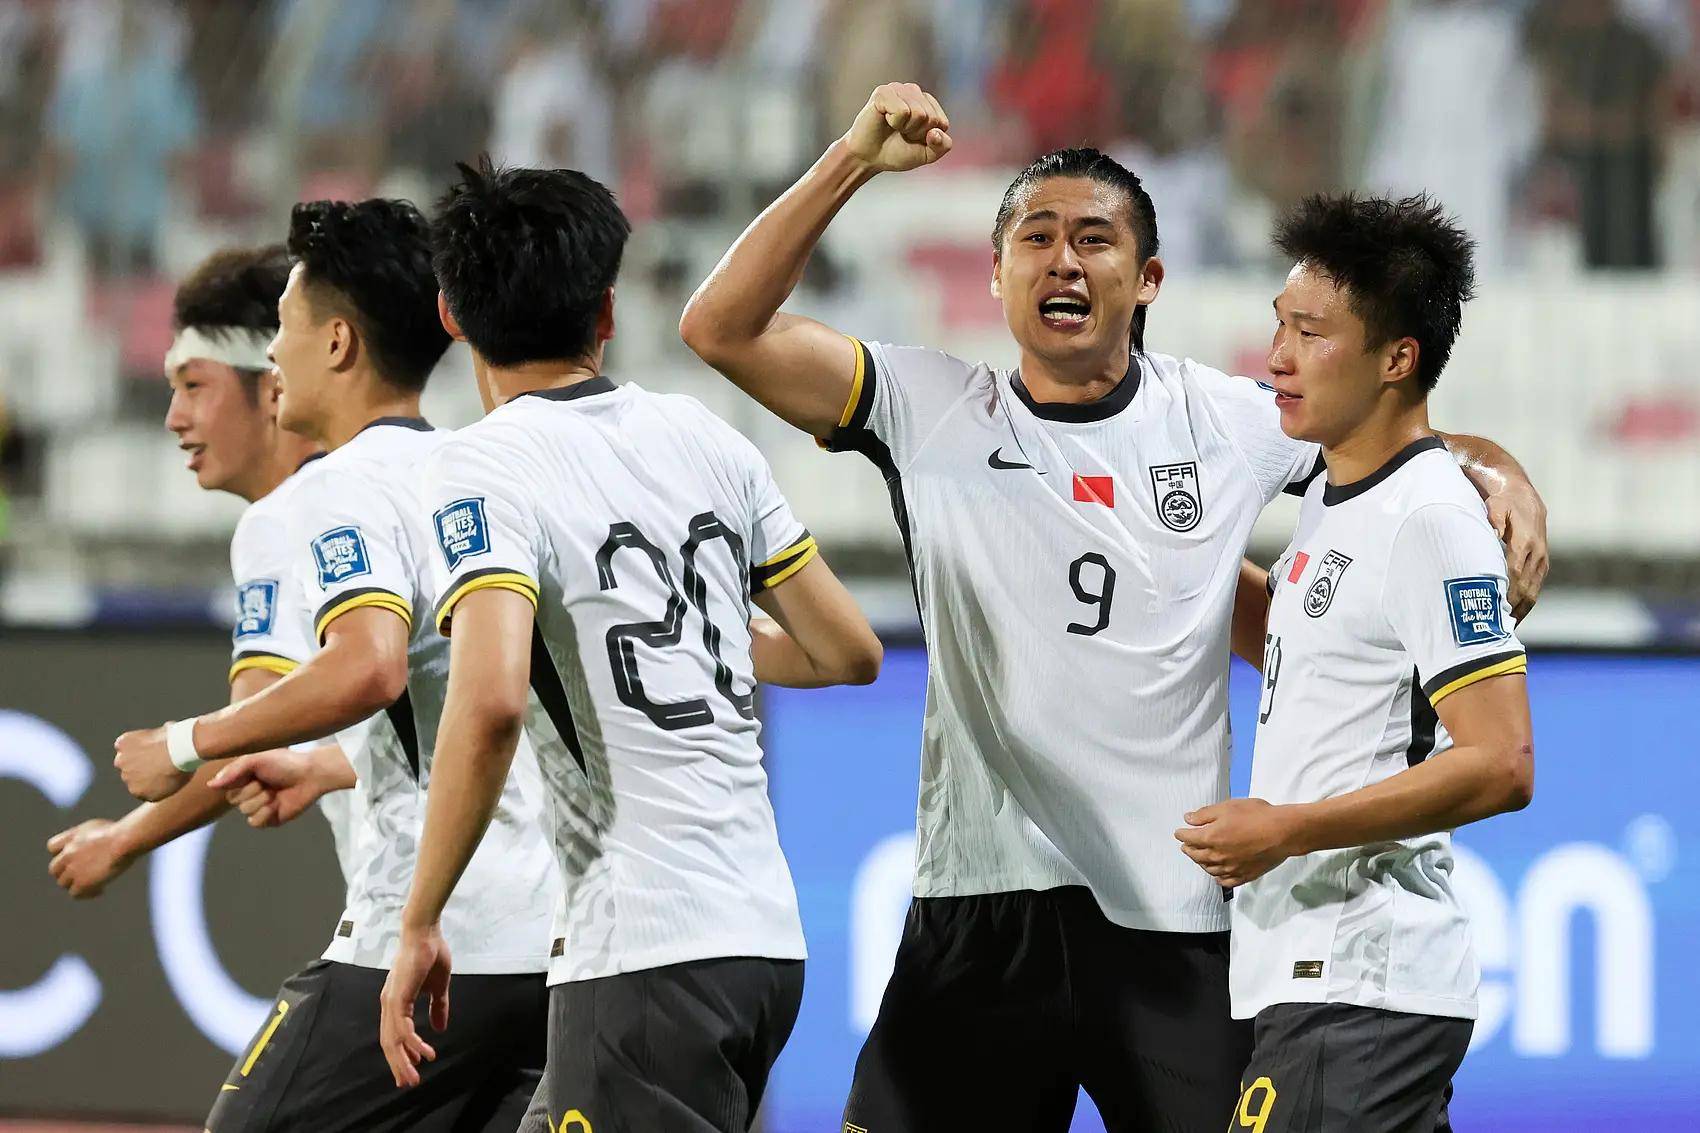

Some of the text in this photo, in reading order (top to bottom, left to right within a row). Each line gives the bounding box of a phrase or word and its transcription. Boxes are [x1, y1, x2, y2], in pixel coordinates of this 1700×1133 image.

[1155, 466, 1194, 482] CFA
[1323, 553, 1347, 572] CFA
[1067, 552, 1116, 636] 9
[1459, 588, 1492, 599] FOOTBALL
[1460, 598, 1493, 611] UNITES
[595, 511, 755, 730] 20
[1460, 610, 1495, 623] the World
